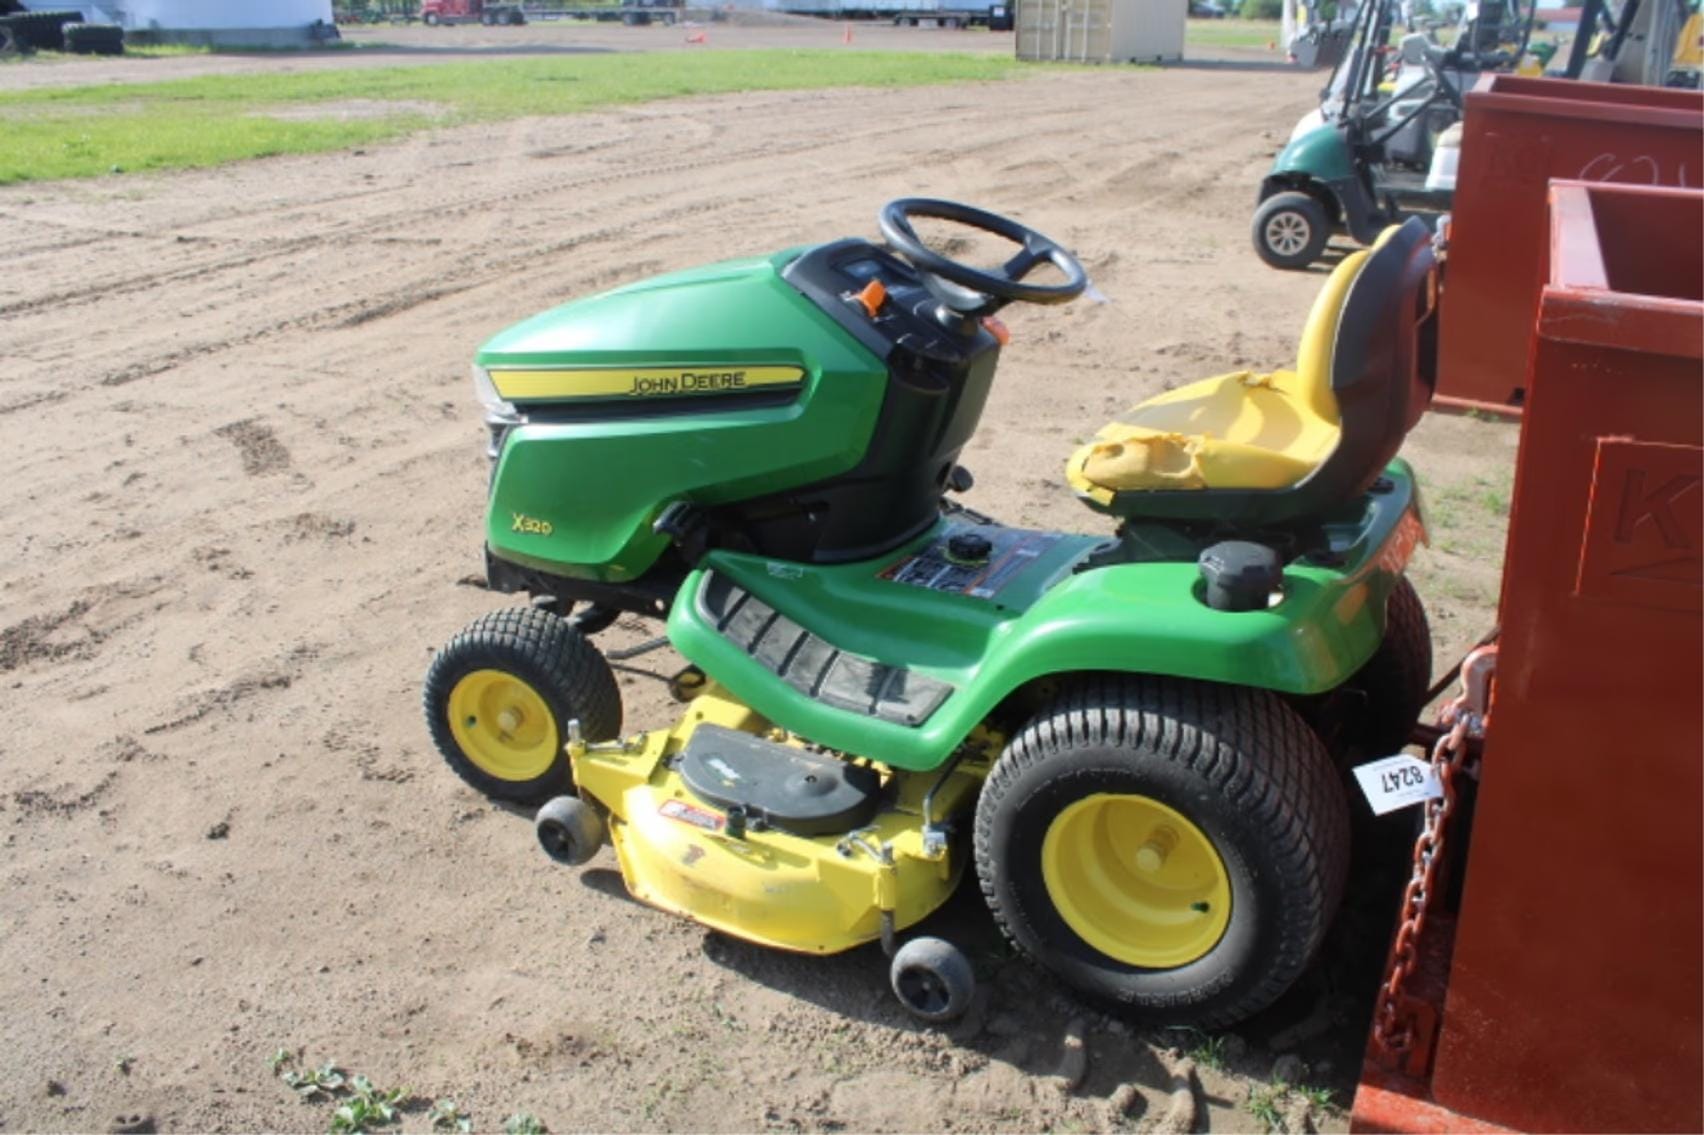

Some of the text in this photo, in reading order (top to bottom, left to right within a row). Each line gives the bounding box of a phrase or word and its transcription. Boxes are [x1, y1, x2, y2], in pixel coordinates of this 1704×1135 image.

[629, 371, 746, 394] JOHN DEERE
[512, 513, 552, 536] X320
[1381, 766, 1424, 793] 8247
